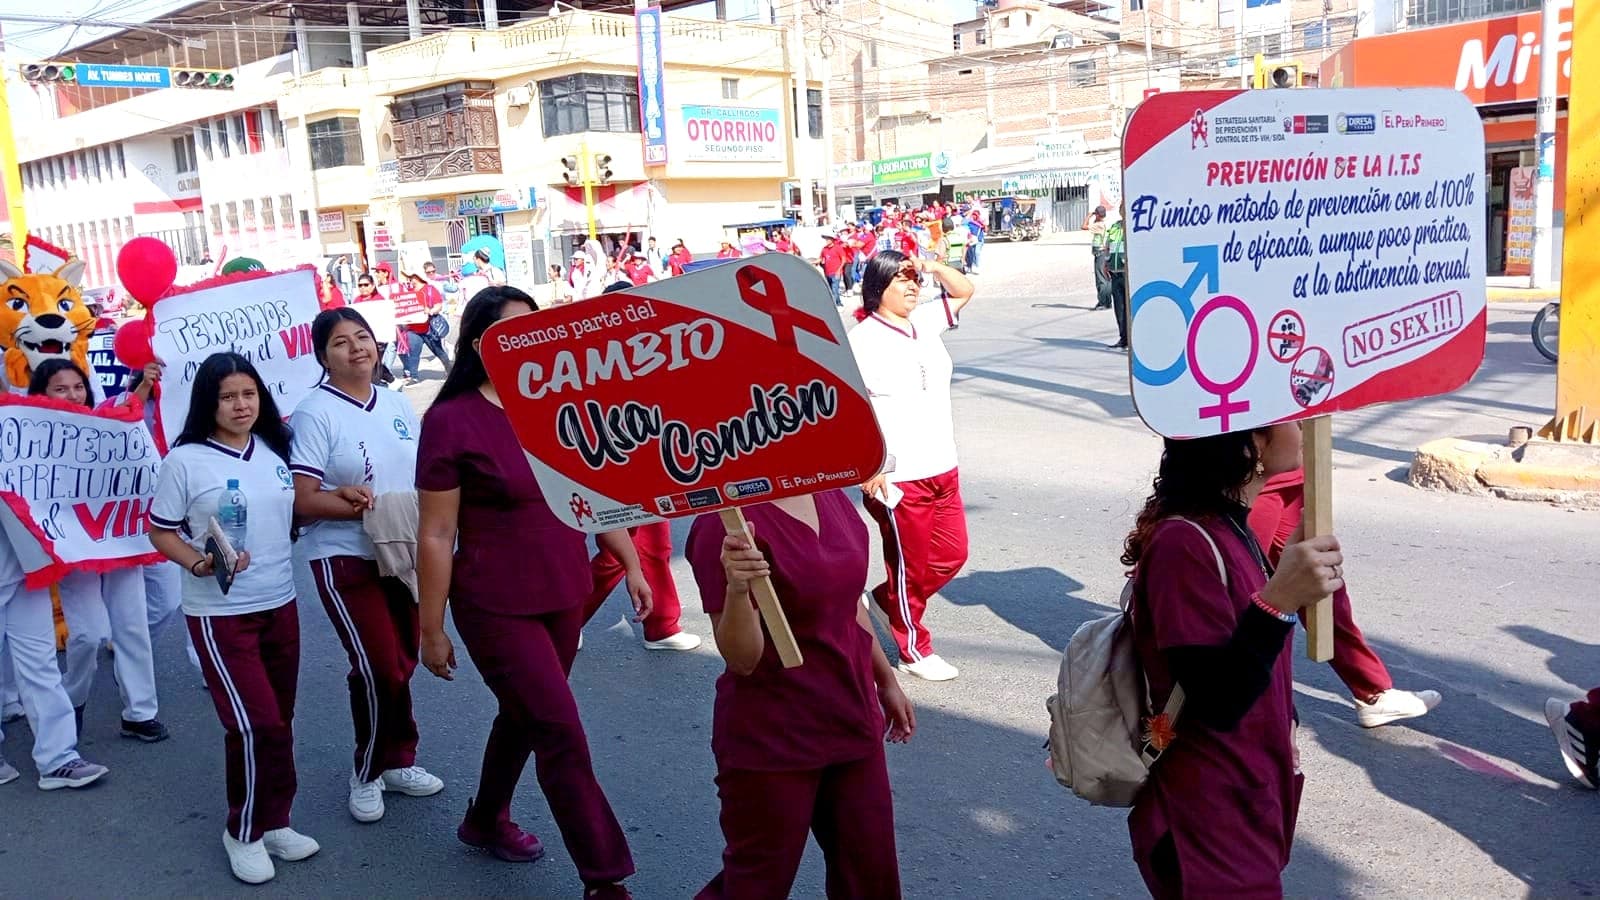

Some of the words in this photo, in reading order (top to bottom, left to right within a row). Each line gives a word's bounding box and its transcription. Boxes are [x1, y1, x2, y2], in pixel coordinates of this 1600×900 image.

[101, 70, 134, 82] TUMBES
[134, 71, 161, 83] NORTE
[687, 118, 775, 143] OTORRINO
[1215, 117, 1248, 125] ESTRATEGIA
[1248, 115, 1276, 124] SANITARIA
[1215, 126, 1224, 135] DE
[704, 144, 744, 153] SEGUNDO
[1215, 135, 1240, 144] CONTROL
[1241, 135, 1249, 143] DE
[873, 157, 929, 176] LABORATORIO
[1206, 151, 1328, 187] PREVENCIÓN
[1363, 154, 1382, 177] LA
[1131, 195, 1158, 233] El
[1160, 197, 1213, 228] único
[1217, 189, 1280, 224] método
[1284, 188, 1304, 219] de
[1306, 186, 1392, 229] prevención
[1395, 190, 1422, 212] con
[1425, 180, 1438, 209] el
[1439, 172, 1475, 209] 100%
[1222, 230, 1244, 263] de
[1247, 227, 1313, 272] eficacia,
[1319, 229, 1375, 262] aunque
[1376, 225, 1412, 260] poco
[1413, 215, 1472, 256] práctica,
[1292, 272, 1309, 298] es
[1313, 261, 1331, 296] la
[1334, 256, 1422, 294] abstinencia
[1423, 247, 1471, 285] sexual.
[158, 299, 293, 355] TENGAMOS
[497, 324, 569, 352] Seamos
[569, 311, 623, 340] parte
[623, 299, 658, 323] del
[1351, 326, 1384, 359] NO
[517, 317, 725, 400] CAMBIO
[556, 399, 663, 469] Usa
[660, 379, 838, 484] Condón
[358, 441, 373, 482] SILVA
[41, 502, 66, 541] el
[71, 496, 154, 544] VIH
